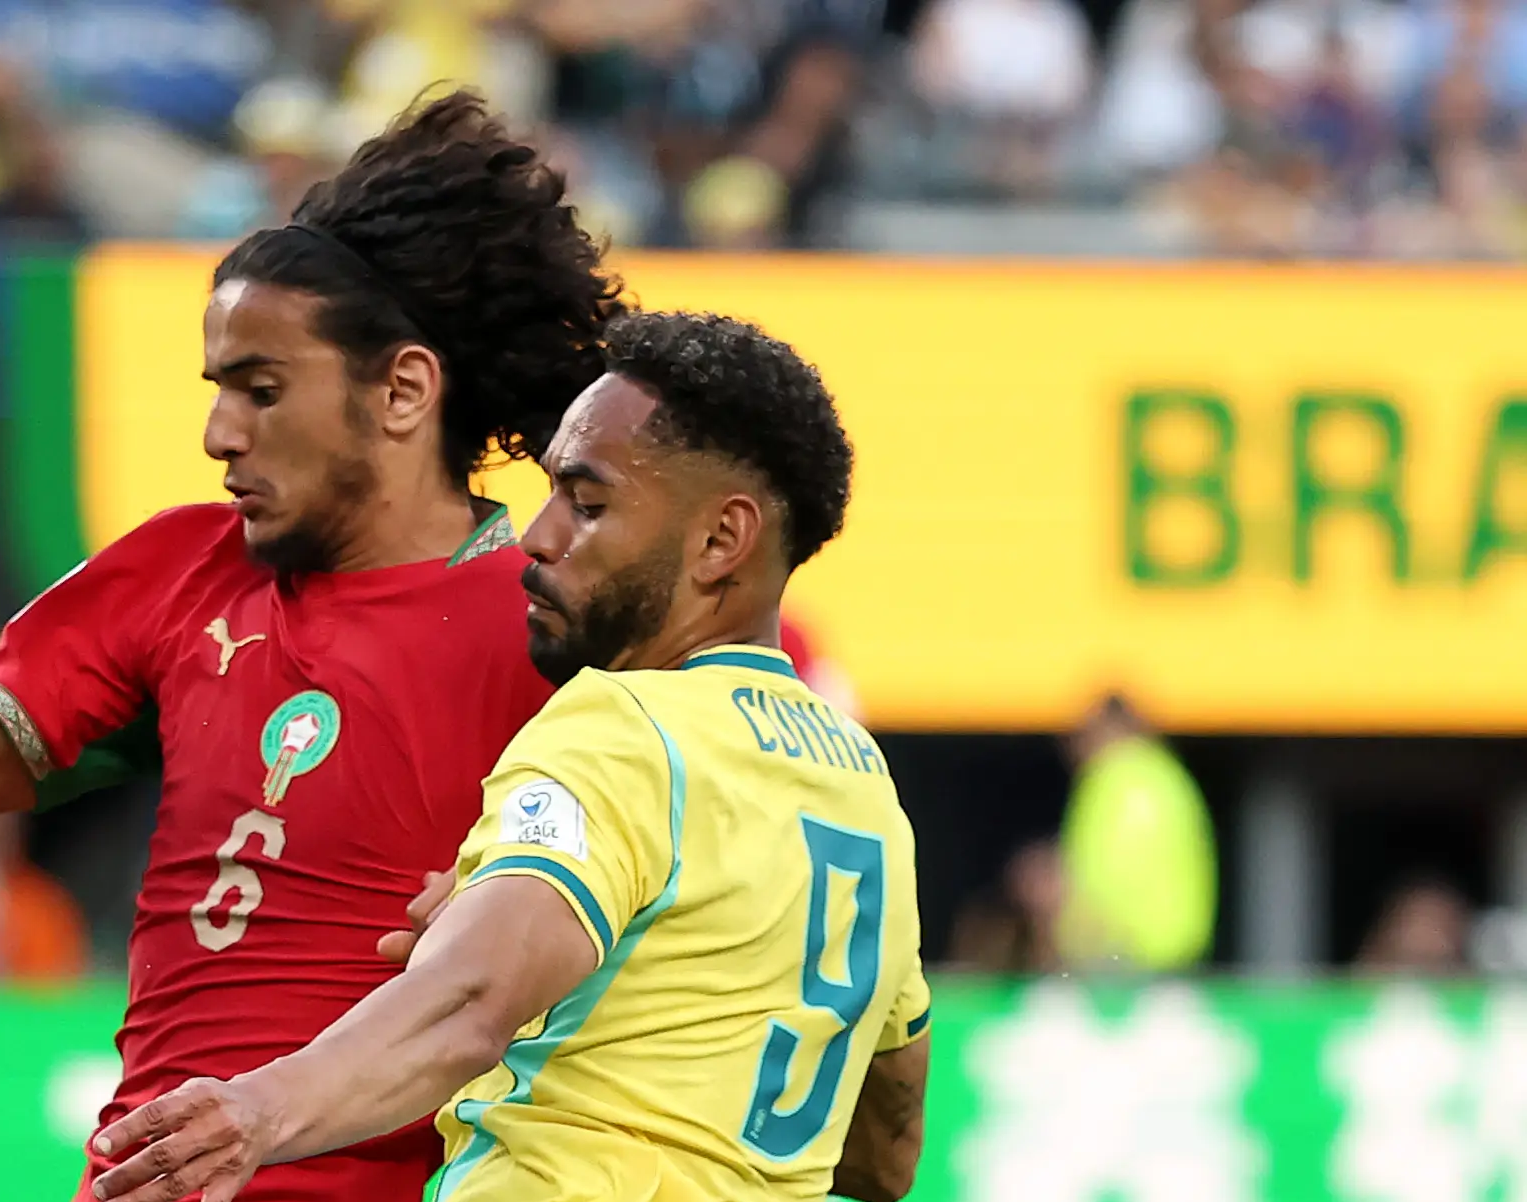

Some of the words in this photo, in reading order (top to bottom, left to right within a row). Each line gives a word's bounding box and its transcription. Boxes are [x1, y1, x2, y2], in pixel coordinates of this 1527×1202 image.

[732, 687, 885, 776] CUNHA
[190, 808, 286, 952] 6
[738, 813, 886, 1163] 9
